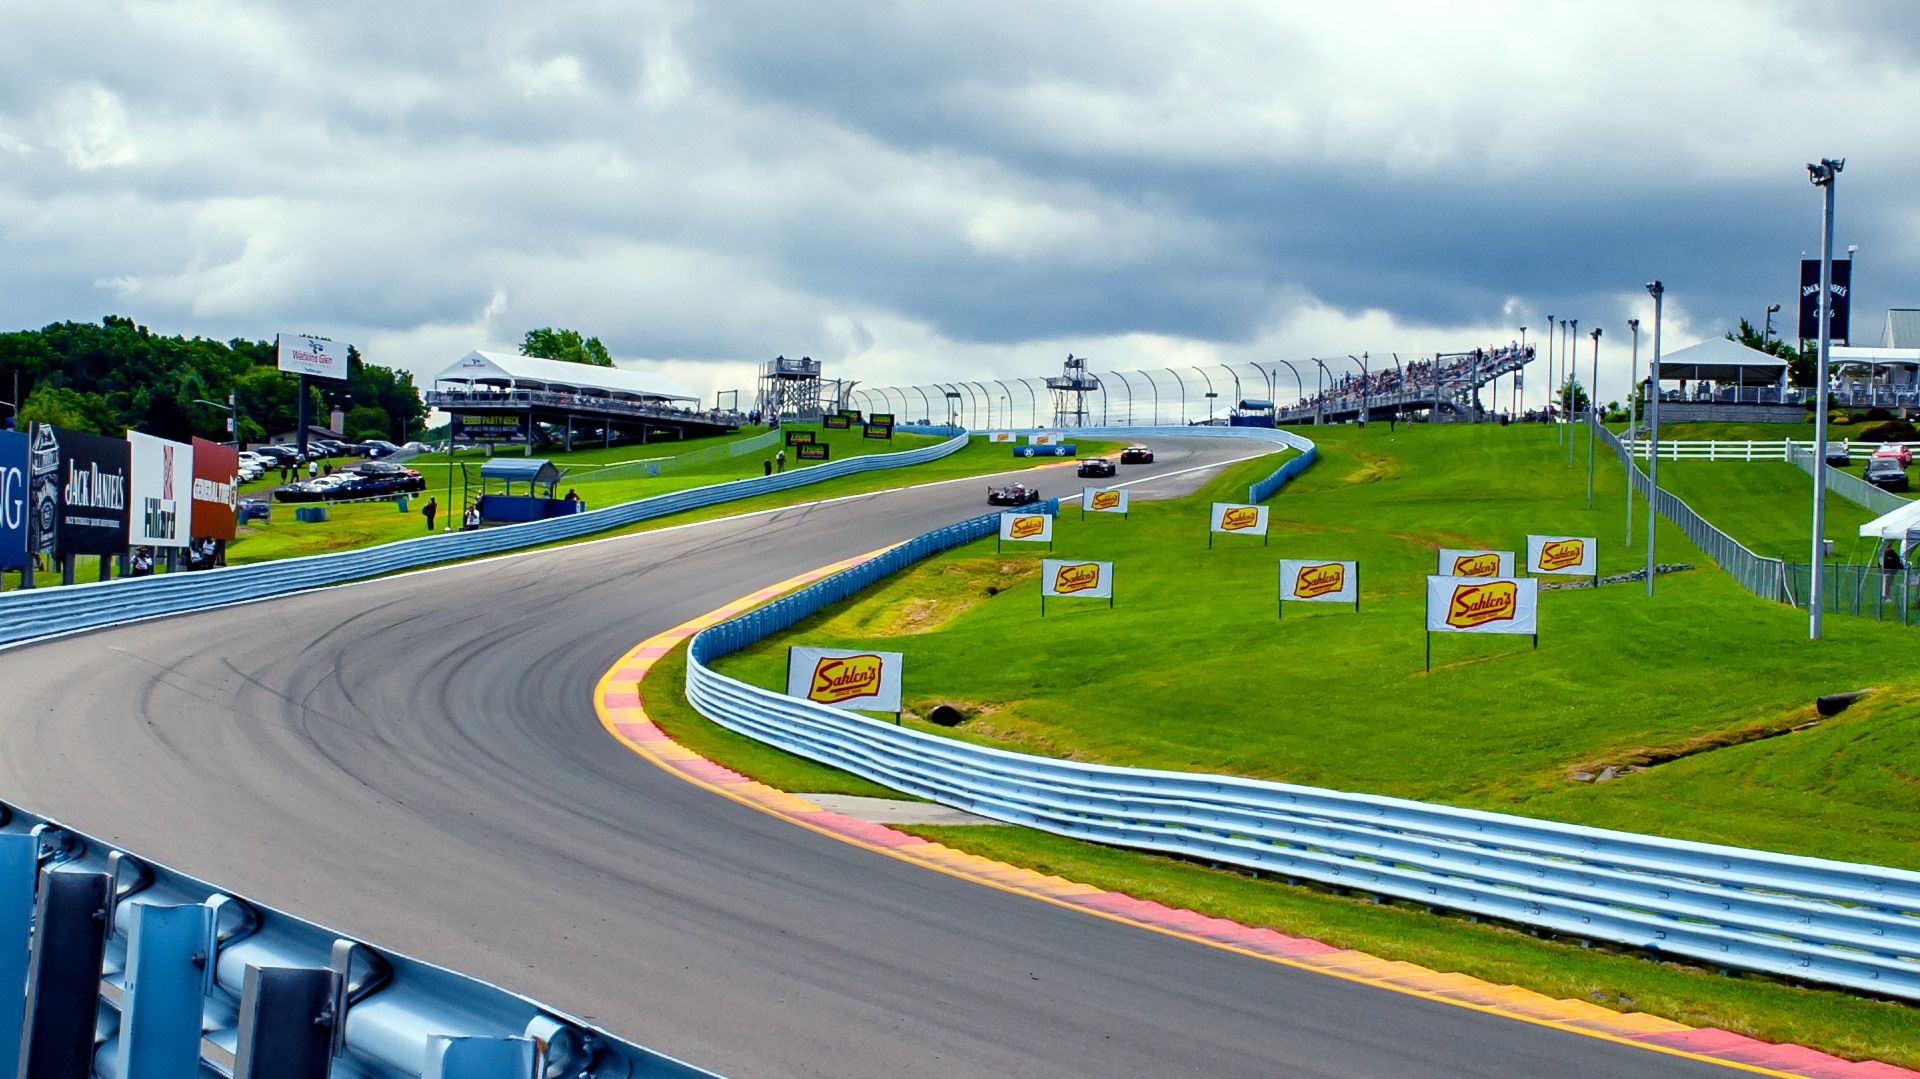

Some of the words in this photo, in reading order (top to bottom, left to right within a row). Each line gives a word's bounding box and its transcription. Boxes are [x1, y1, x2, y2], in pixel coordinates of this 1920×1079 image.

[1300, 569, 1340, 591] Sahlen's
[1455, 587, 1511, 617] Sahlen's
[816, 660, 876, 692] Sahlen's
